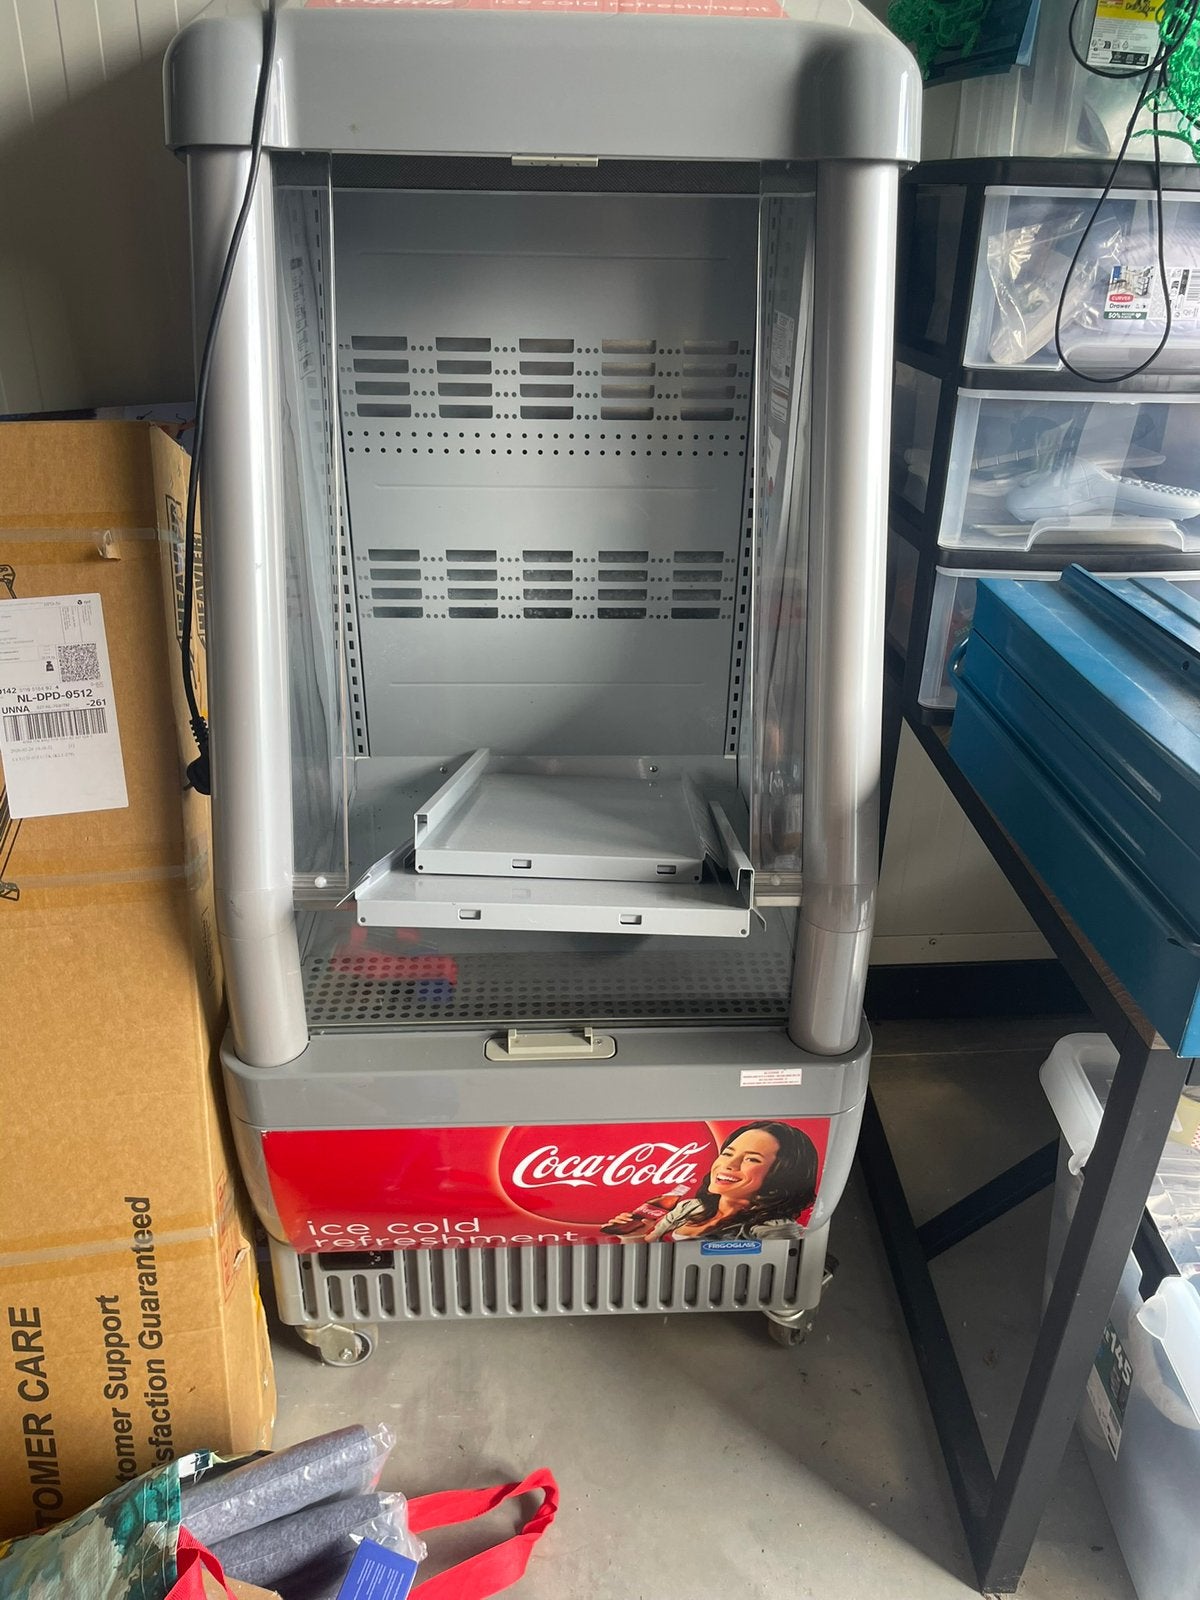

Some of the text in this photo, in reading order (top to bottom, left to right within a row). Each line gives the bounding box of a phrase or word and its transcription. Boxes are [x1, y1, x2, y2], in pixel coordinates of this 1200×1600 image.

[609, 1, 770, 12] refreshment
[17, 688, 93, 703] NL-DPD-0512
[86, 698, 107, 707] -261
[1, 705, 30, 714] UNNA
[511, 1141, 711, 1188] Coca-Cola
[306, 1217, 480, 1236] ice cold
[314, 1231, 579, 1248] refreshment
[124, 1197, 163, 1350] Guaranteed
[8, 1307, 49, 1402] CARE
[95, 1295, 131, 1400] Support
